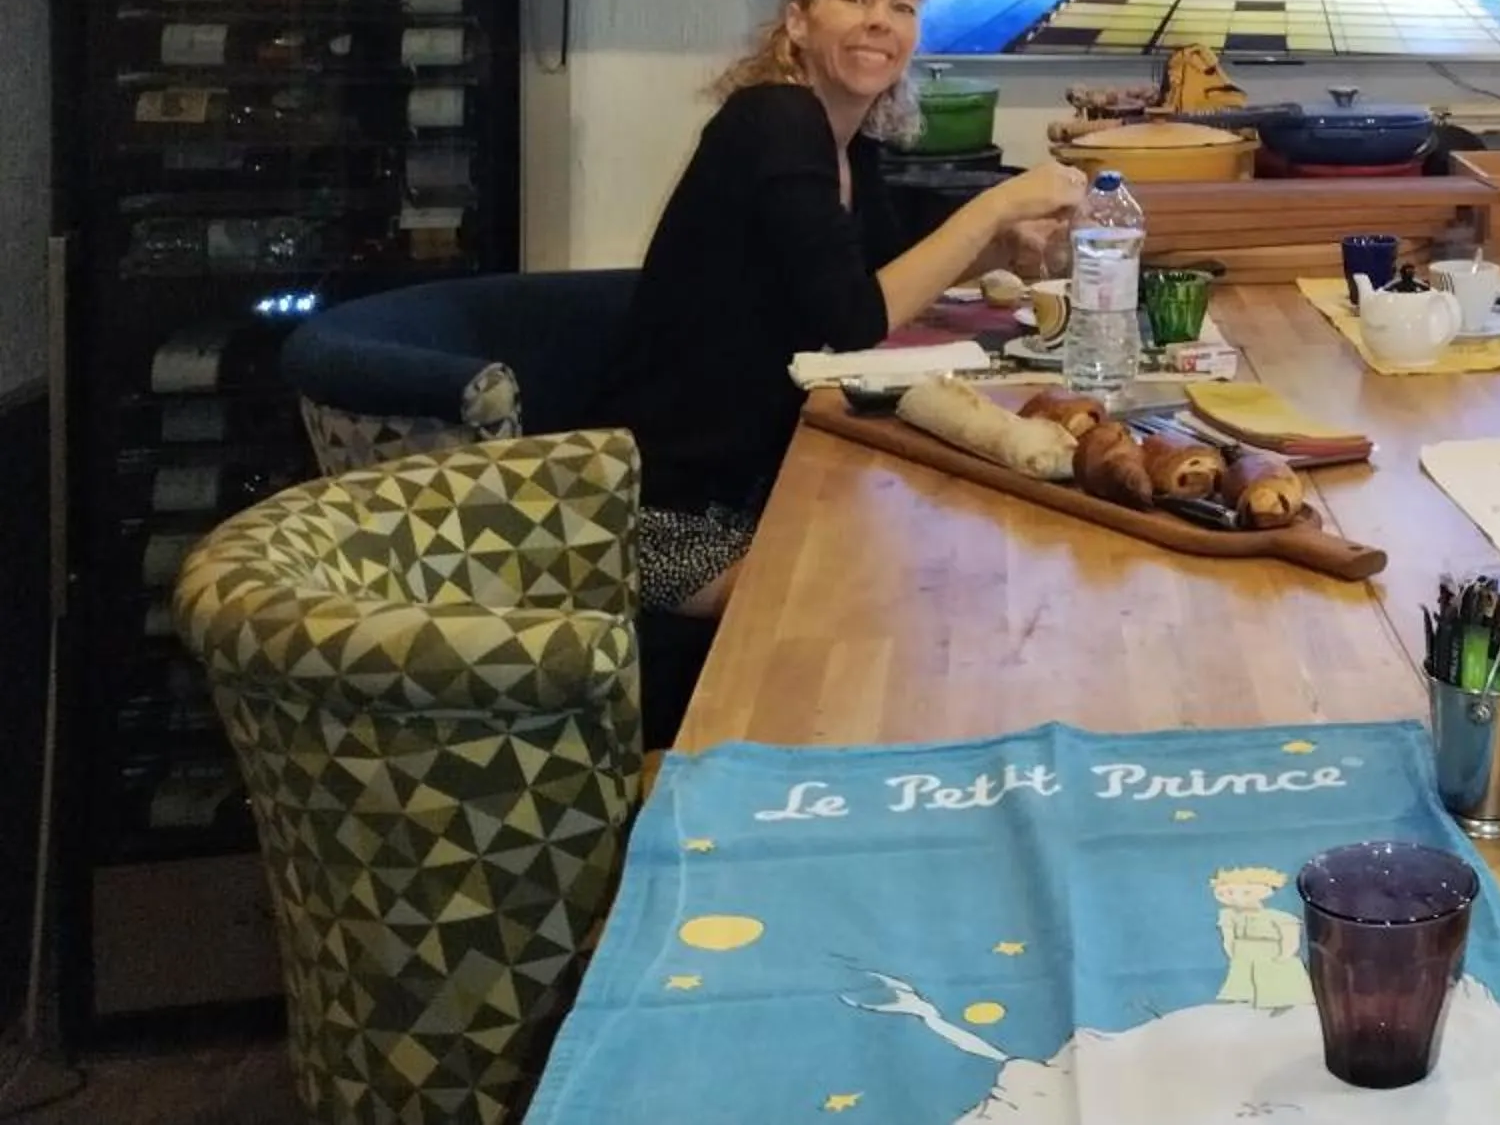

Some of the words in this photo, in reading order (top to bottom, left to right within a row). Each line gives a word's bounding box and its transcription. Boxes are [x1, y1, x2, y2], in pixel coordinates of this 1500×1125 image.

[754, 781, 849, 820] Le
[885, 763, 1060, 812] Petit
[1091, 763, 1346, 800] Prince
